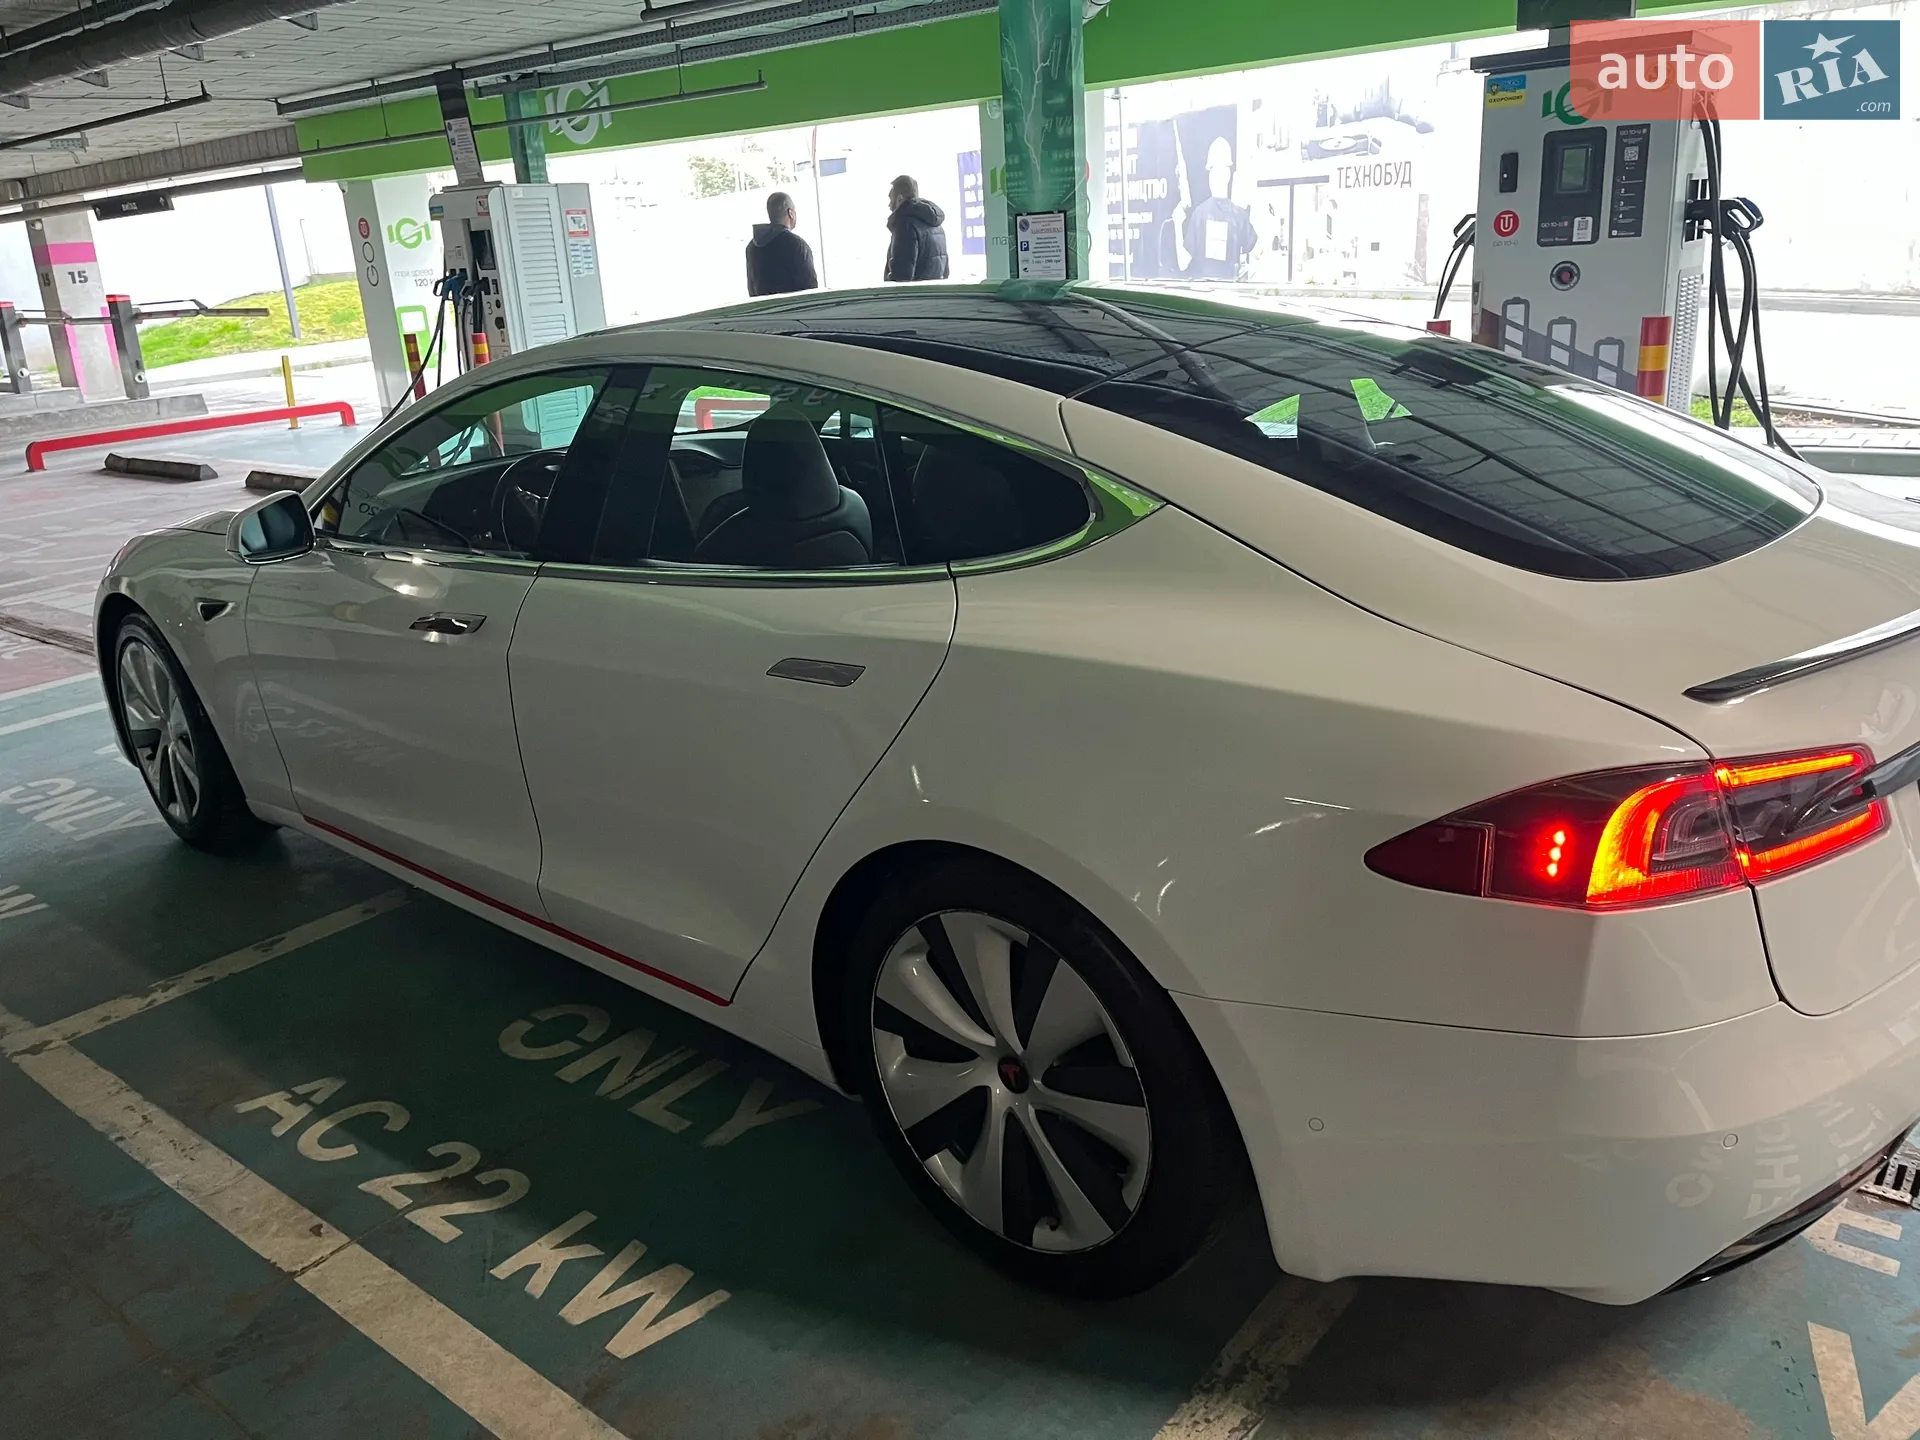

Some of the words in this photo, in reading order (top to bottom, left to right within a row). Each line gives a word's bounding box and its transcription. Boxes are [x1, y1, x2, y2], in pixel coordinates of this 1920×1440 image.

[1337, 161, 1412, 189] ТЕХНОБУД
[67, 270, 89, 284] 15
[410, 268, 434, 278] speed
[414, 278, 428, 287] 120
[498, 1004, 821, 1148] ONLY
[235, 1076, 411, 1161] AC
[357, 1141, 531, 1244] 22
[488, 1210, 732, 1360] kW
